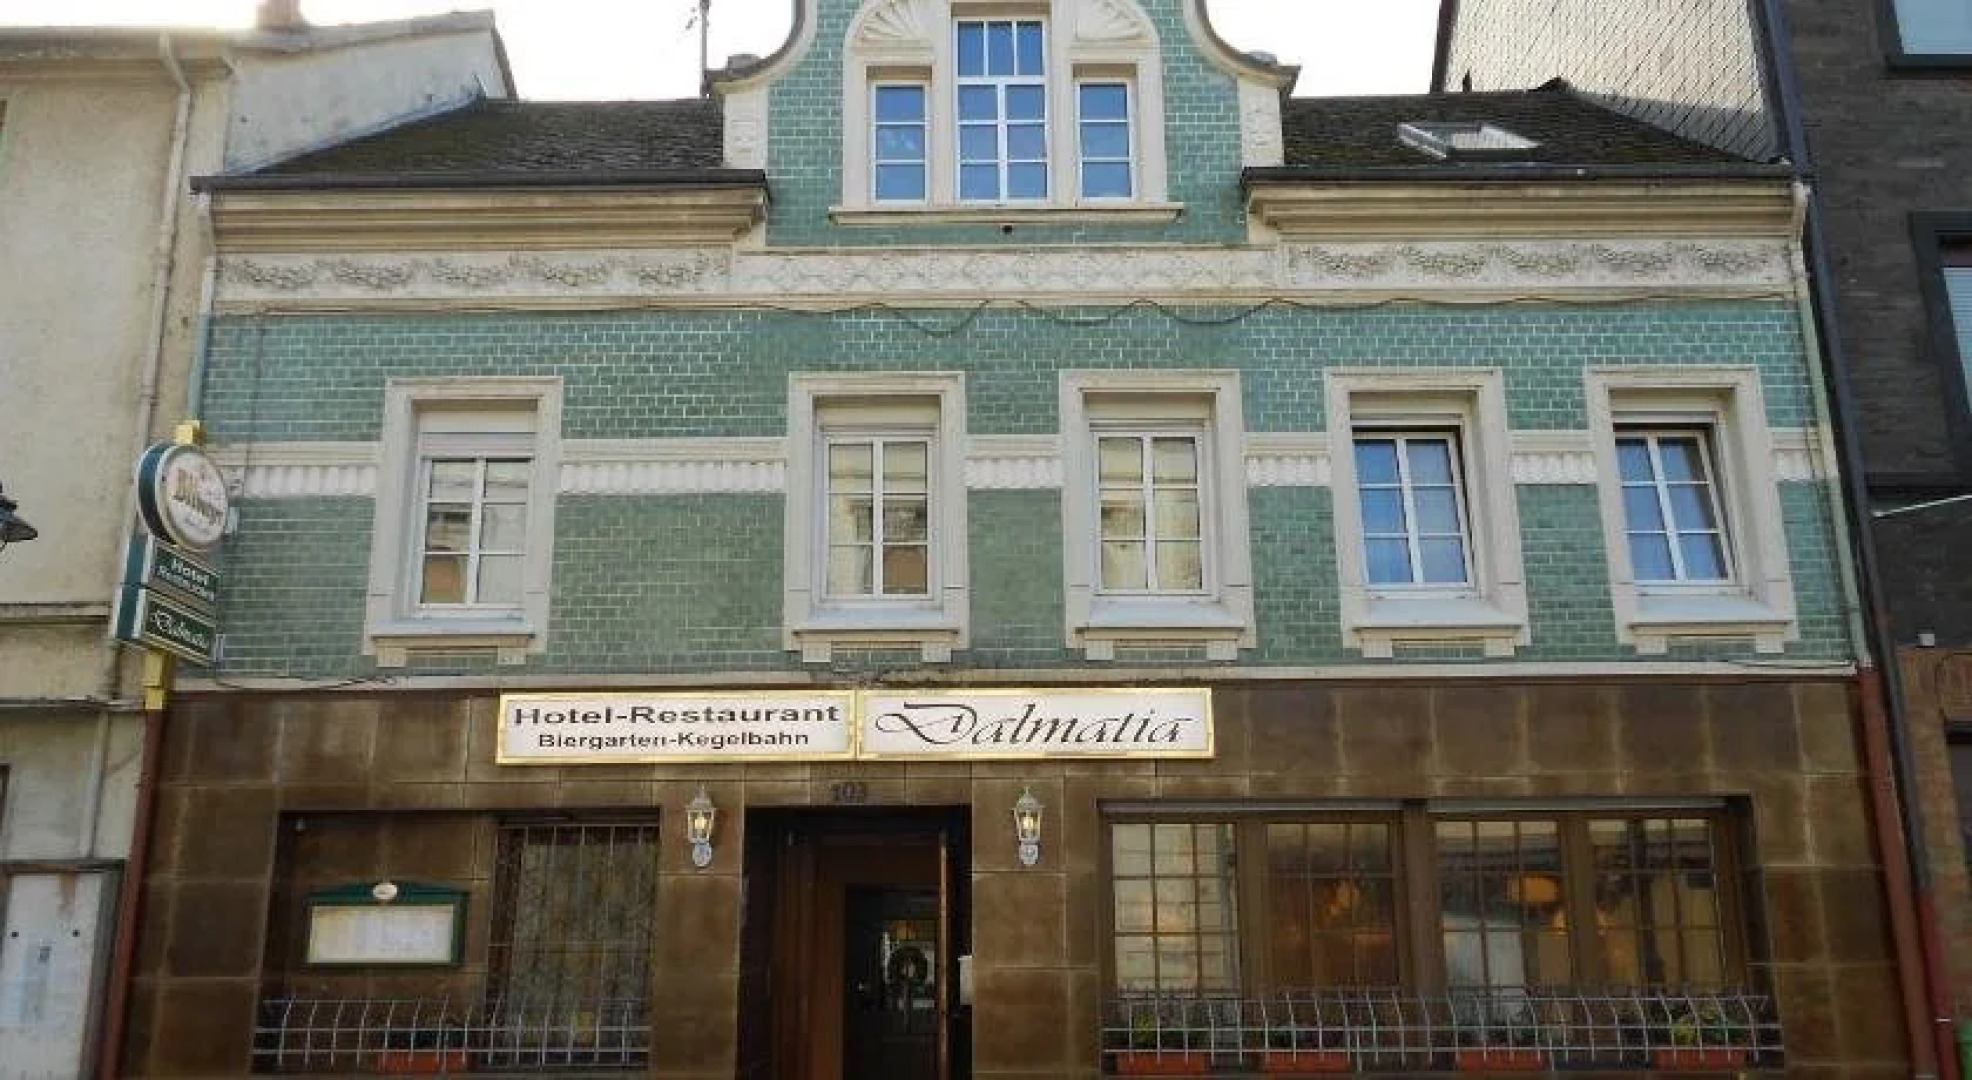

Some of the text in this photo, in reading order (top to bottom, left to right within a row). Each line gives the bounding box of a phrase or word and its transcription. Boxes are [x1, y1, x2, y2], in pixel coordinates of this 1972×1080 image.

[515, 705, 839, 725] Hotel-Restaurant
[875, 702, 1194, 745] Dalmatia
[538, 732, 810, 750] Biergarten-Kegelbahn
